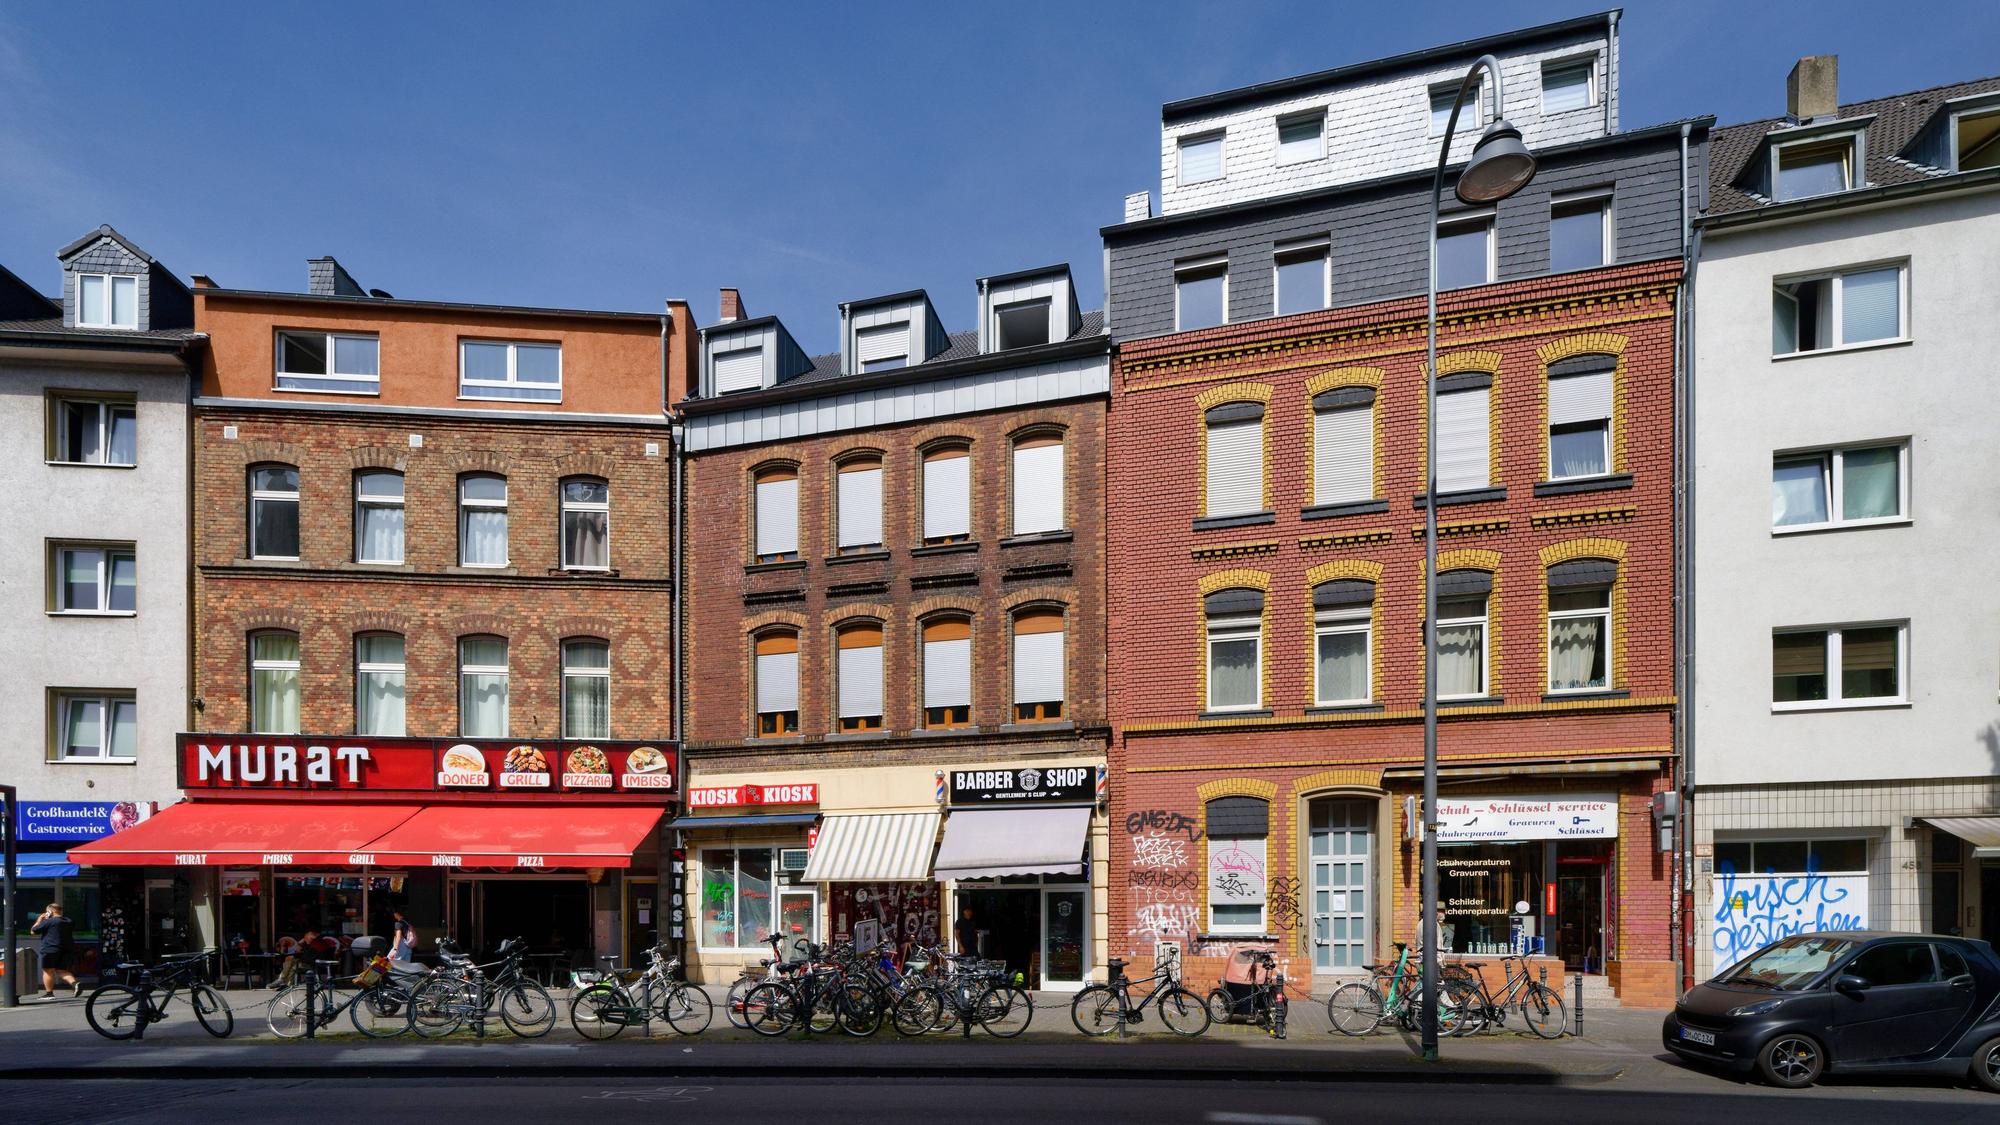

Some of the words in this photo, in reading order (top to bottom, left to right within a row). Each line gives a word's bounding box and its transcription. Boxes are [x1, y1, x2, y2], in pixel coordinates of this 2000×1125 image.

[507, 774, 543, 786] GRILL
[564, 774, 612, 787] PIZZARIA
[625, 775, 670, 787] IMBISS
[956, 771, 1013, 790] BARBER
[1046, 768, 1088, 787] SHOP
[690, 788, 738, 806] KIOSK
[763, 785, 813, 803] KIOSK
[1488, 802, 1551, 814] Schlüssel
[1557, 802, 1607, 812] service
[27, 822, 105, 834] Gastroservice
[1509, 818, 1556, 827] Gravuren
[1558, 827, 1604, 836] Schlüssel
[175, 854, 207, 865] MURAT
[262, 854, 293, 865] IMBISS
[349, 854, 376, 865] GRILL
[432, 854, 462, 866] DÖNER
[517, 856, 544, 867] PIZZA
[1449, 869, 1489, 877] Gravuren
[672, 861, 684, 938] KIOSK
[1449, 898, 1485, 906] Schilder
